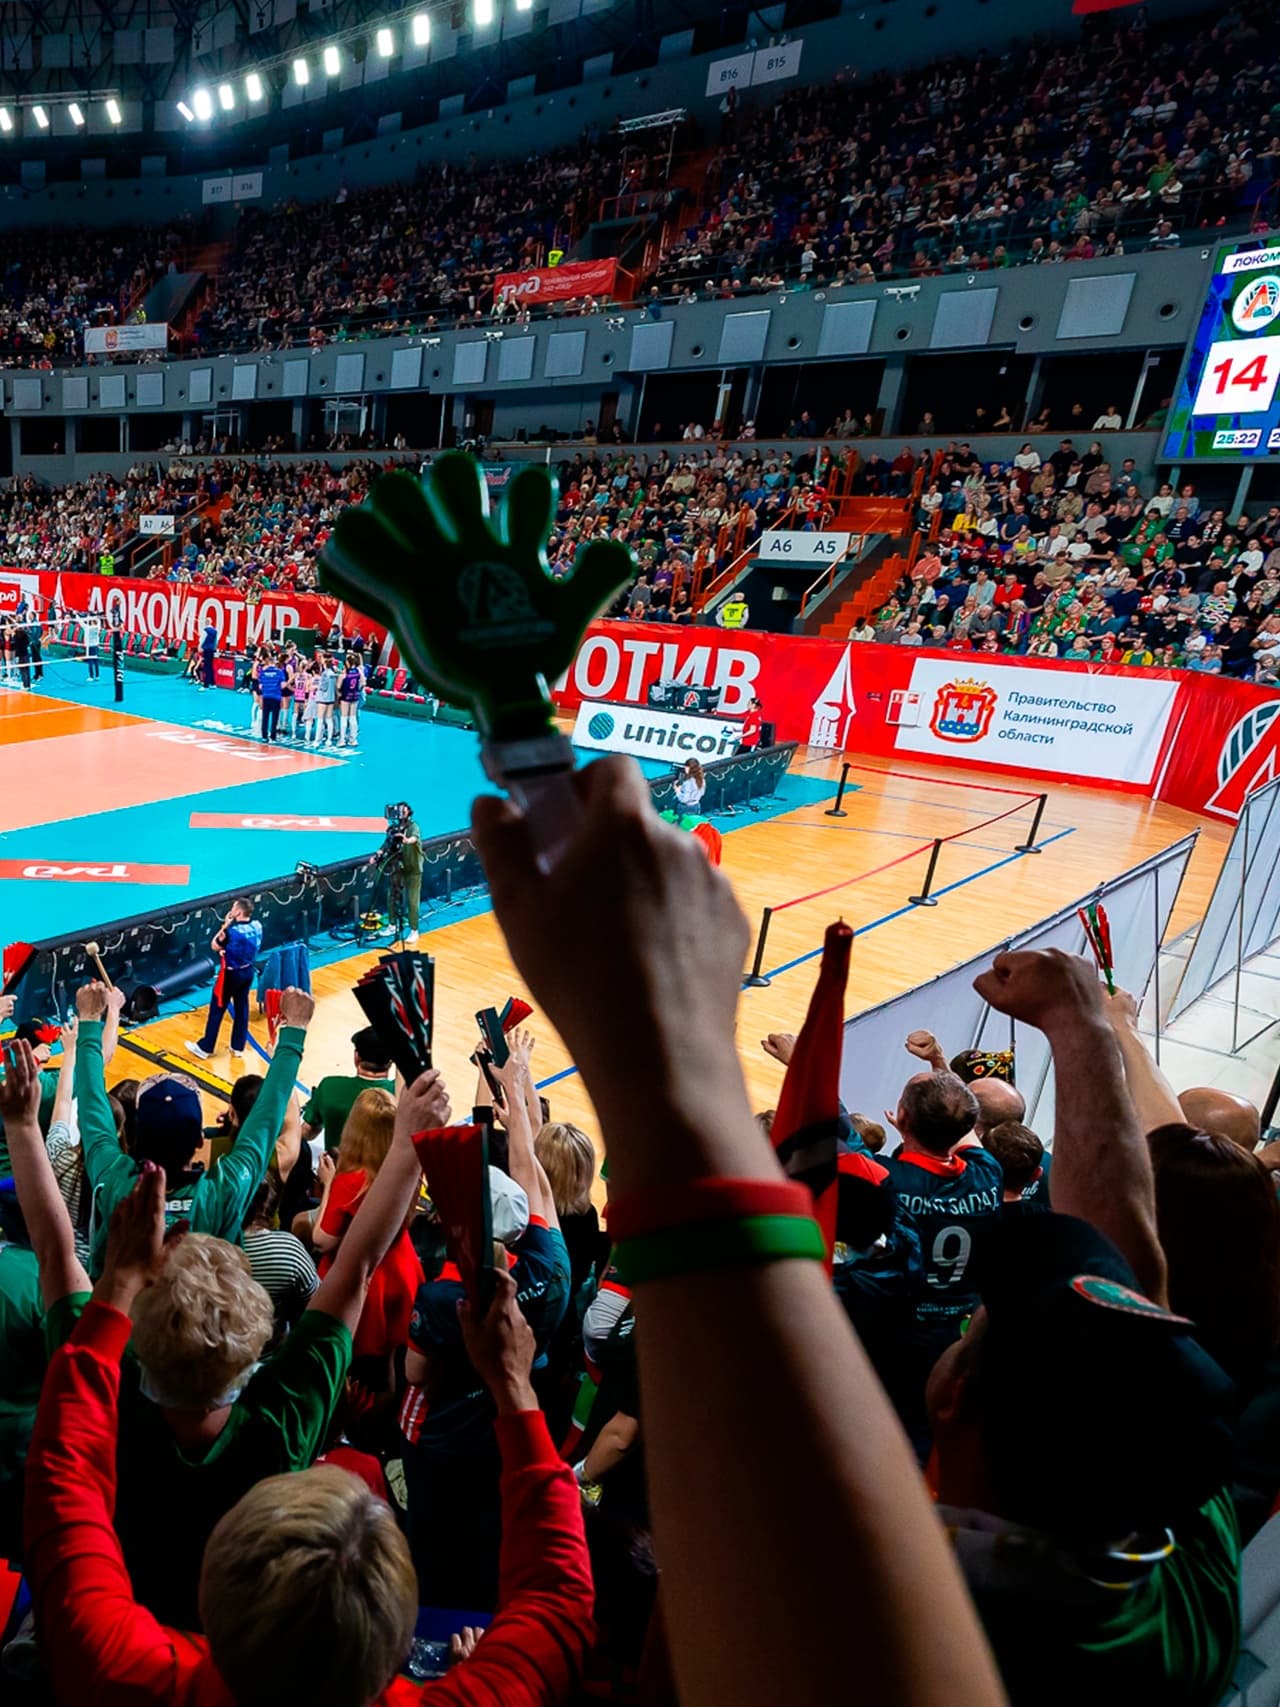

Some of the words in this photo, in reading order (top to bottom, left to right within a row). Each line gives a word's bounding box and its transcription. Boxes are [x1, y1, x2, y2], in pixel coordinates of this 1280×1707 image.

[1213, 354, 1268, 394] 14
[1216, 432, 1258, 445] 25:22
[770, 539, 792, 552] A6
[812, 540, 836, 554] A5
[1007, 690, 1117, 715] Правительство
[1002, 709, 1134, 736] Калининградской
[998, 728, 1055, 745] области
[927, 1225, 971, 1289] 9
